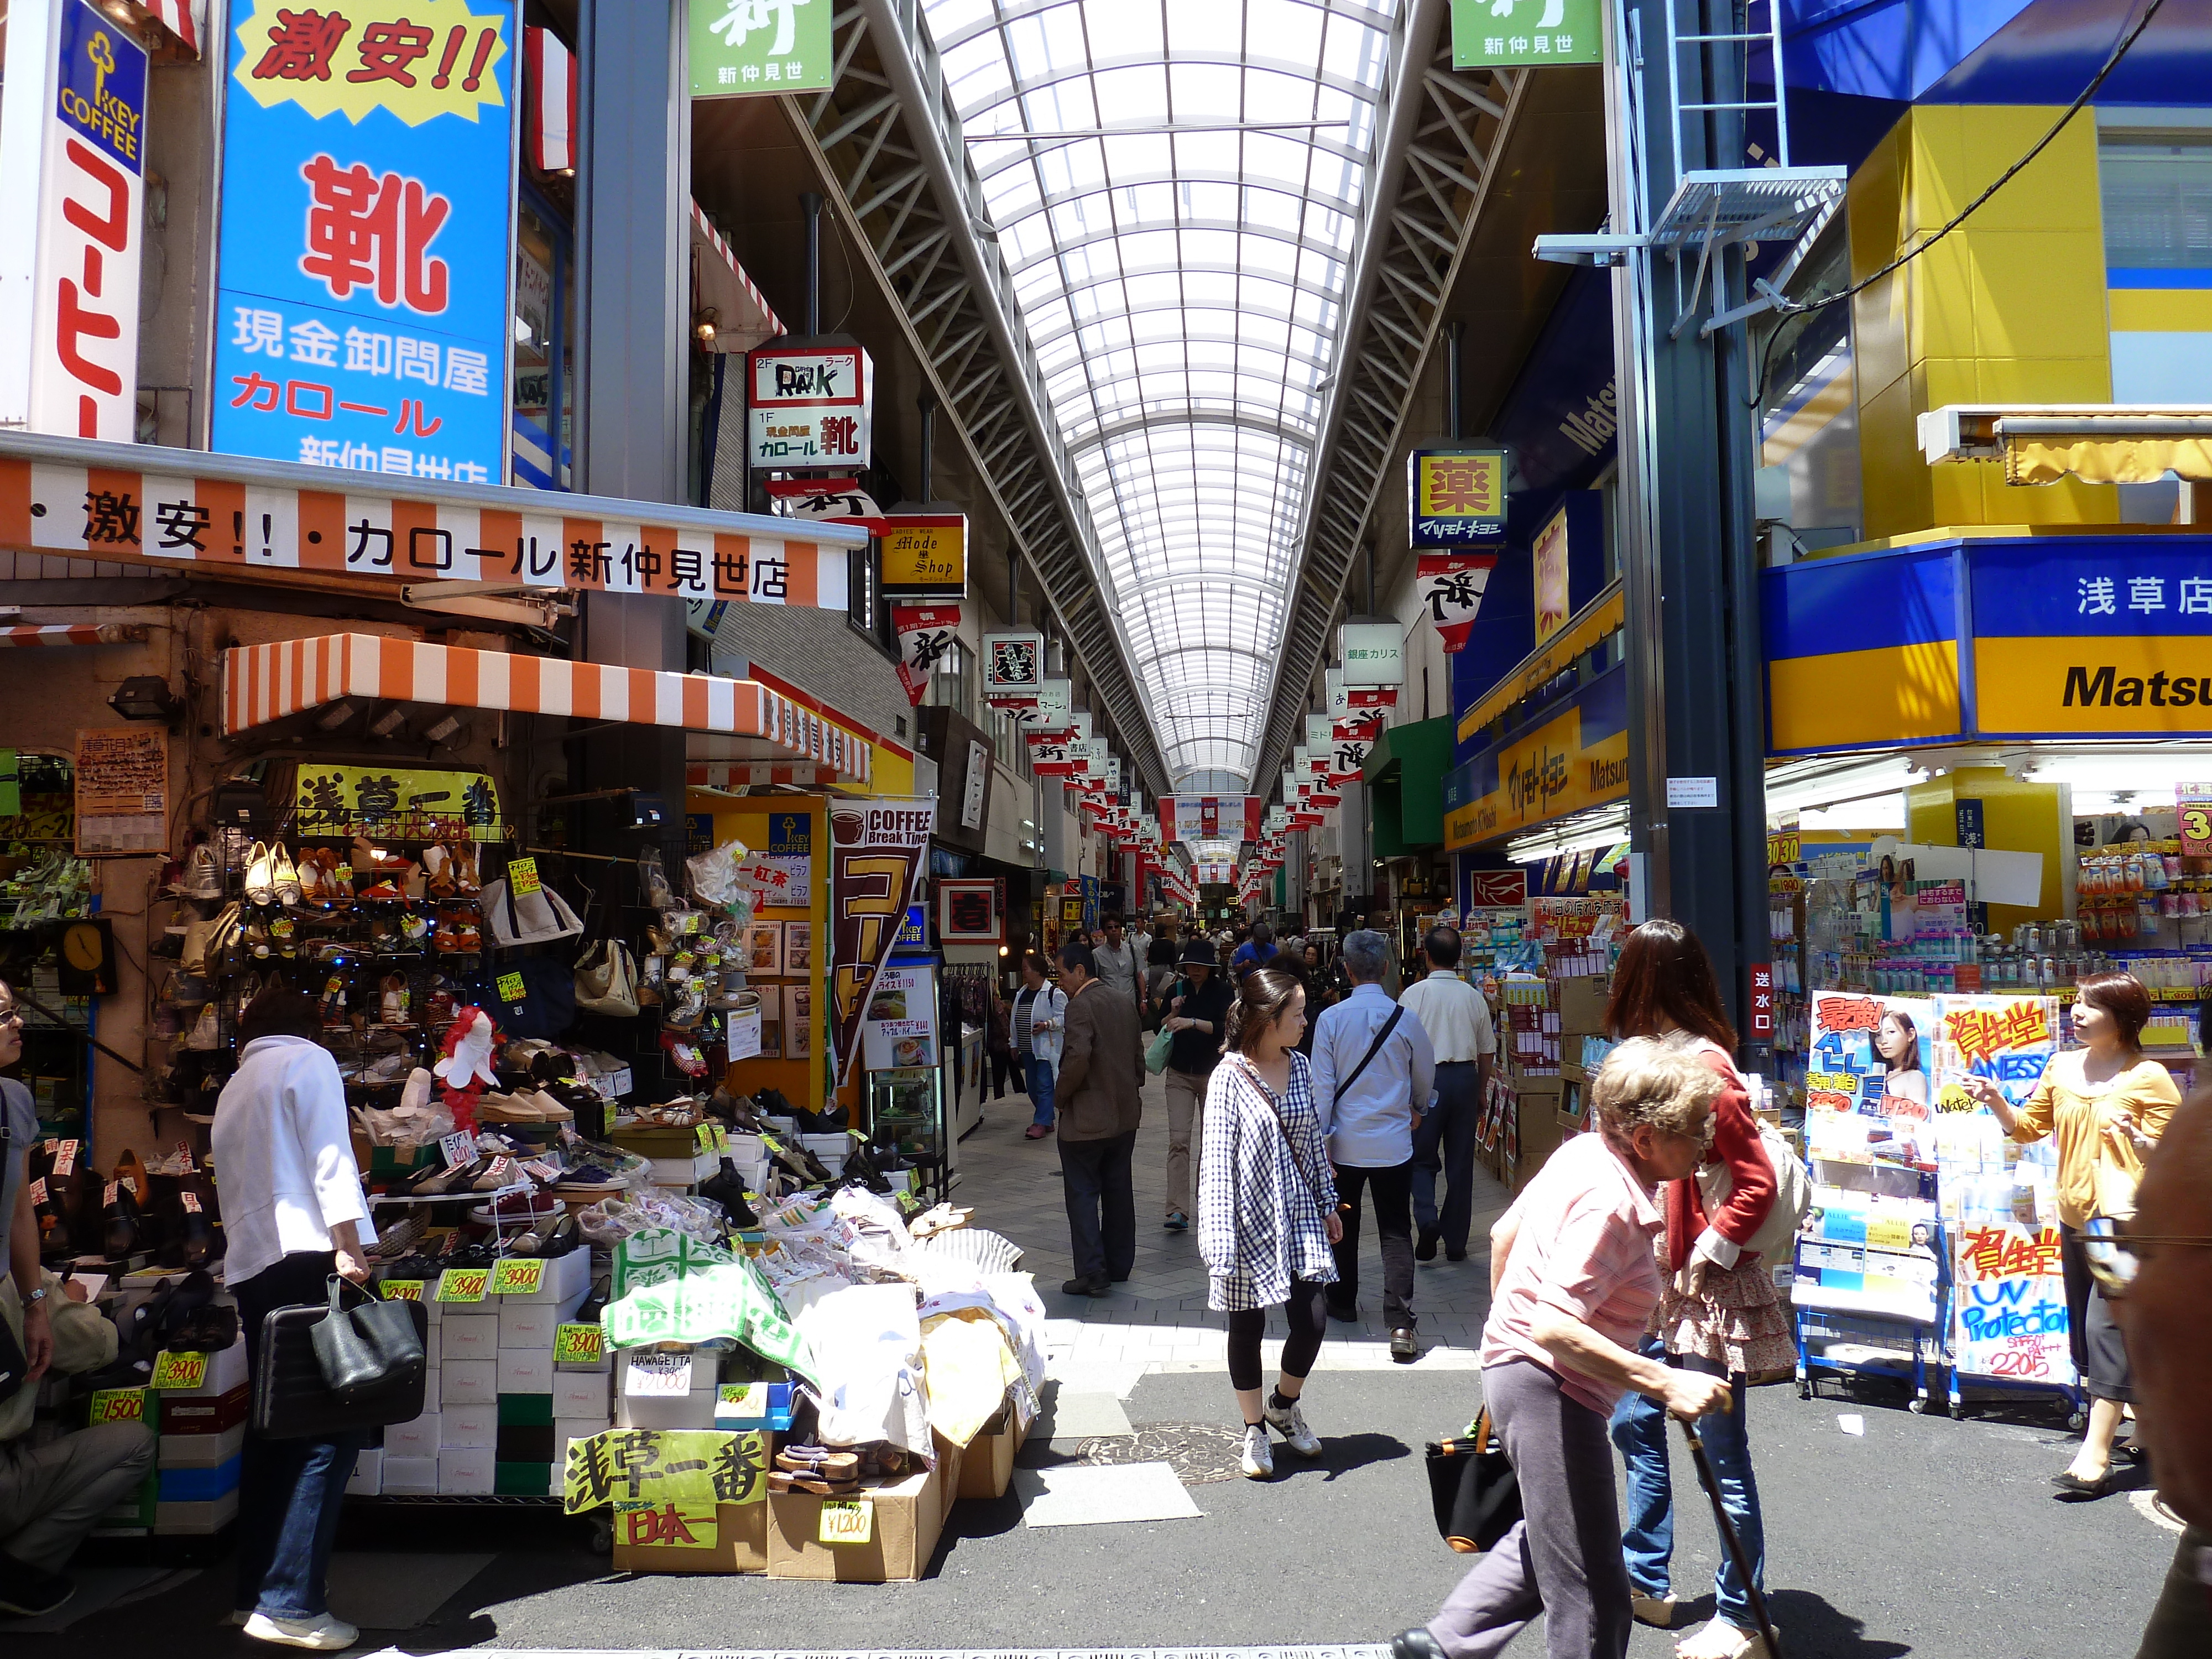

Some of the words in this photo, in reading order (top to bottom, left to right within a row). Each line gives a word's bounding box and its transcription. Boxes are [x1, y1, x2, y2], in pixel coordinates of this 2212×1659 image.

[252, 8, 497, 92] 激安!!
[1484, 35, 1573, 55] 新仲見世
[718, 61, 802, 84] 新仲見世
[61, 88, 137, 161] COFFEE
[105, 96, 141, 133] KEY
[304, 156, 448, 313] 靴
[58, 138, 129, 438] コーヒー
[232, 306, 488, 396] 現金卸問屋
[757, 358, 773, 369] 2F
[825, 357, 853, 368] ラーク
[231, 372, 442, 437] カロール
[759, 413, 775, 423] 1F
[766, 425, 811, 437] 現金問屋
[820, 416, 858, 455] 靴
[759, 440, 818, 457] カロール
[1430, 460, 1490, 513] 薬
[1419, 520, 1501, 538] マツモトキヨシ
[894, 536, 937, 551] Mode
[911, 560, 953, 576] Shop
[2077, 576, 2212, 615] 浅草店
[910, 630, 951, 671] 新
[1348, 649, 1399, 660] 銀座カリス
[1034, 745, 1067, 760] 新
[299, 772, 496, 827] 浅草一番
[869, 810, 931, 831] COFFEE
[790, 834, 809, 843] KEY
[869, 832, 902, 843] Break
[771, 844, 809, 852] COFFEE
[895, 933, 921, 942] OFFEE
[1755, 972, 1770, 1029] 送水口
[1817, 997, 1884, 1031] 最強!
[1945, 1000, 2049, 1068] 資生堂
[1934, 1098, 1977, 1114] Water
[445, 1134, 462, 1152] たび
[1963, 1226, 2062, 1281] 資生堂
[451, 1276, 487, 1295] 3900
[505, 1268, 539, 1285] 3900
[1972, 1280, 2032, 1306] UV
[568, 1333, 601, 1353] 3900
[168, 1360, 201, 1379] 3900
[631, 1356, 691, 1366] HAWAGETTA
[1990, 1352, 2049, 1377] 2205
[103, 1399, 144, 1420] 1500
[565, 1431, 766, 1512] 浅草一番
[627, 1503, 717, 1546] 日本一
[829, 1514, 866, 1533] ¥1200
